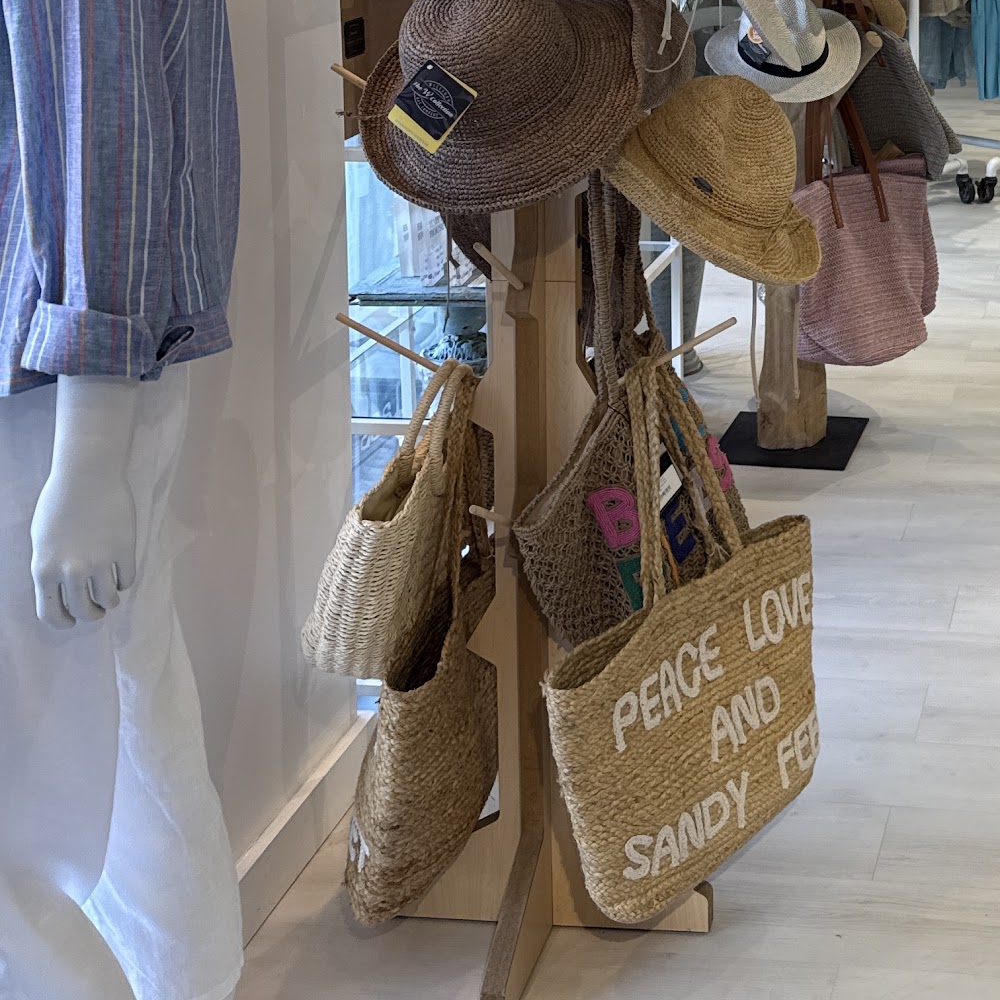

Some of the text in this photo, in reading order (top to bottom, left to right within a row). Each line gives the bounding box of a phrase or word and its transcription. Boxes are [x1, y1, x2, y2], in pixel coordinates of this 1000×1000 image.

[423, 88, 434, 97] W
[613, 624, 724, 752] PEACE
[743, 573, 812, 651] LOVE
[711, 676, 780, 762] AND
[623, 713, 820, 880] SANDY FEE
